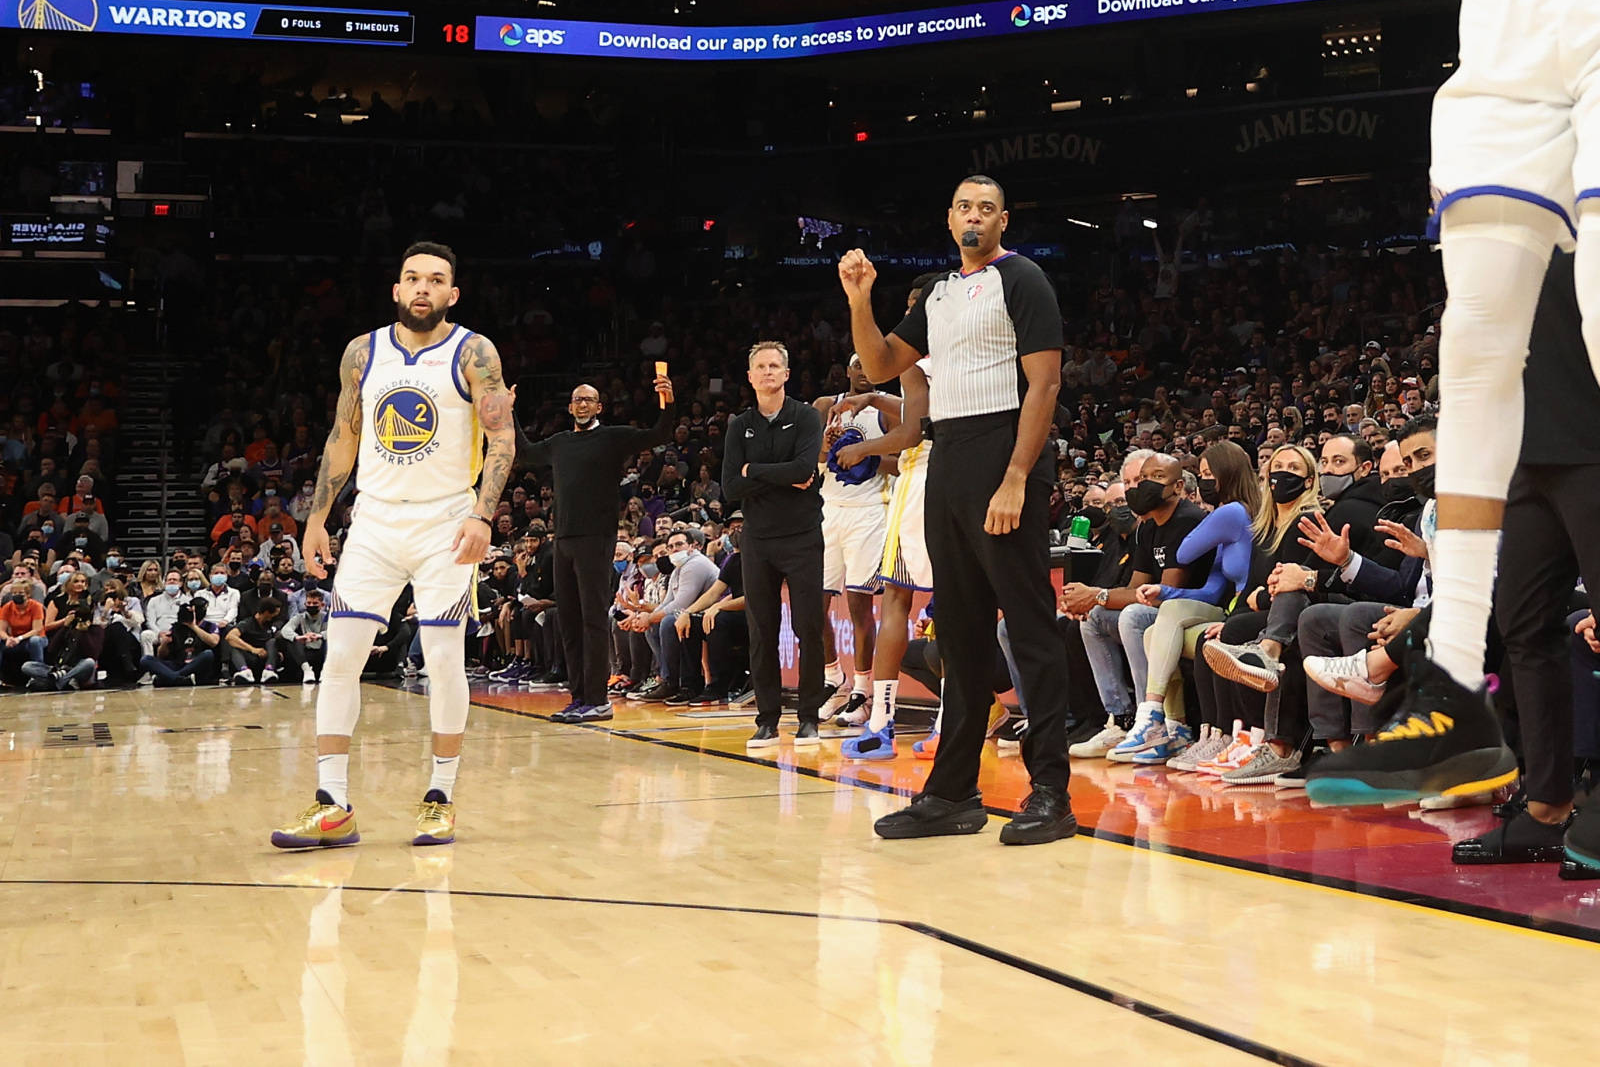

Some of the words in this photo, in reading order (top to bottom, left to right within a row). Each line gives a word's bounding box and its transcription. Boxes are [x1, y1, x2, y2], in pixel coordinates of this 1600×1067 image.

[108, 5, 246, 30] WARRIORS
[281, 17, 289, 29] 0
[292, 19, 321, 29] FOULS
[1033, 3, 1069, 25] aps
[345, 21, 353, 32] 5
[354, 22, 400, 33] TIMEOUTS
[443, 24, 469, 44] 18
[525, 28, 566, 48] aps
[599, 31, 691, 51] Download
[696, 38, 728, 51] our
[732, 37, 768, 53] app
[772, 33, 798, 49] for
[801, 30, 853, 47] access
[856, 26, 874, 41] to
[877, 22, 914, 41] your
[917, 12, 986, 34] account.
[1235, 107, 1379, 153] JAMESON
[968, 132, 1101, 175] JAMESON
[374, 379, 411, 401] GOLDEN
[414, 379, 440, 400] STATE
[414, 403, 427, 423] 2
[374, 439, 440, 466] WARRIORS
